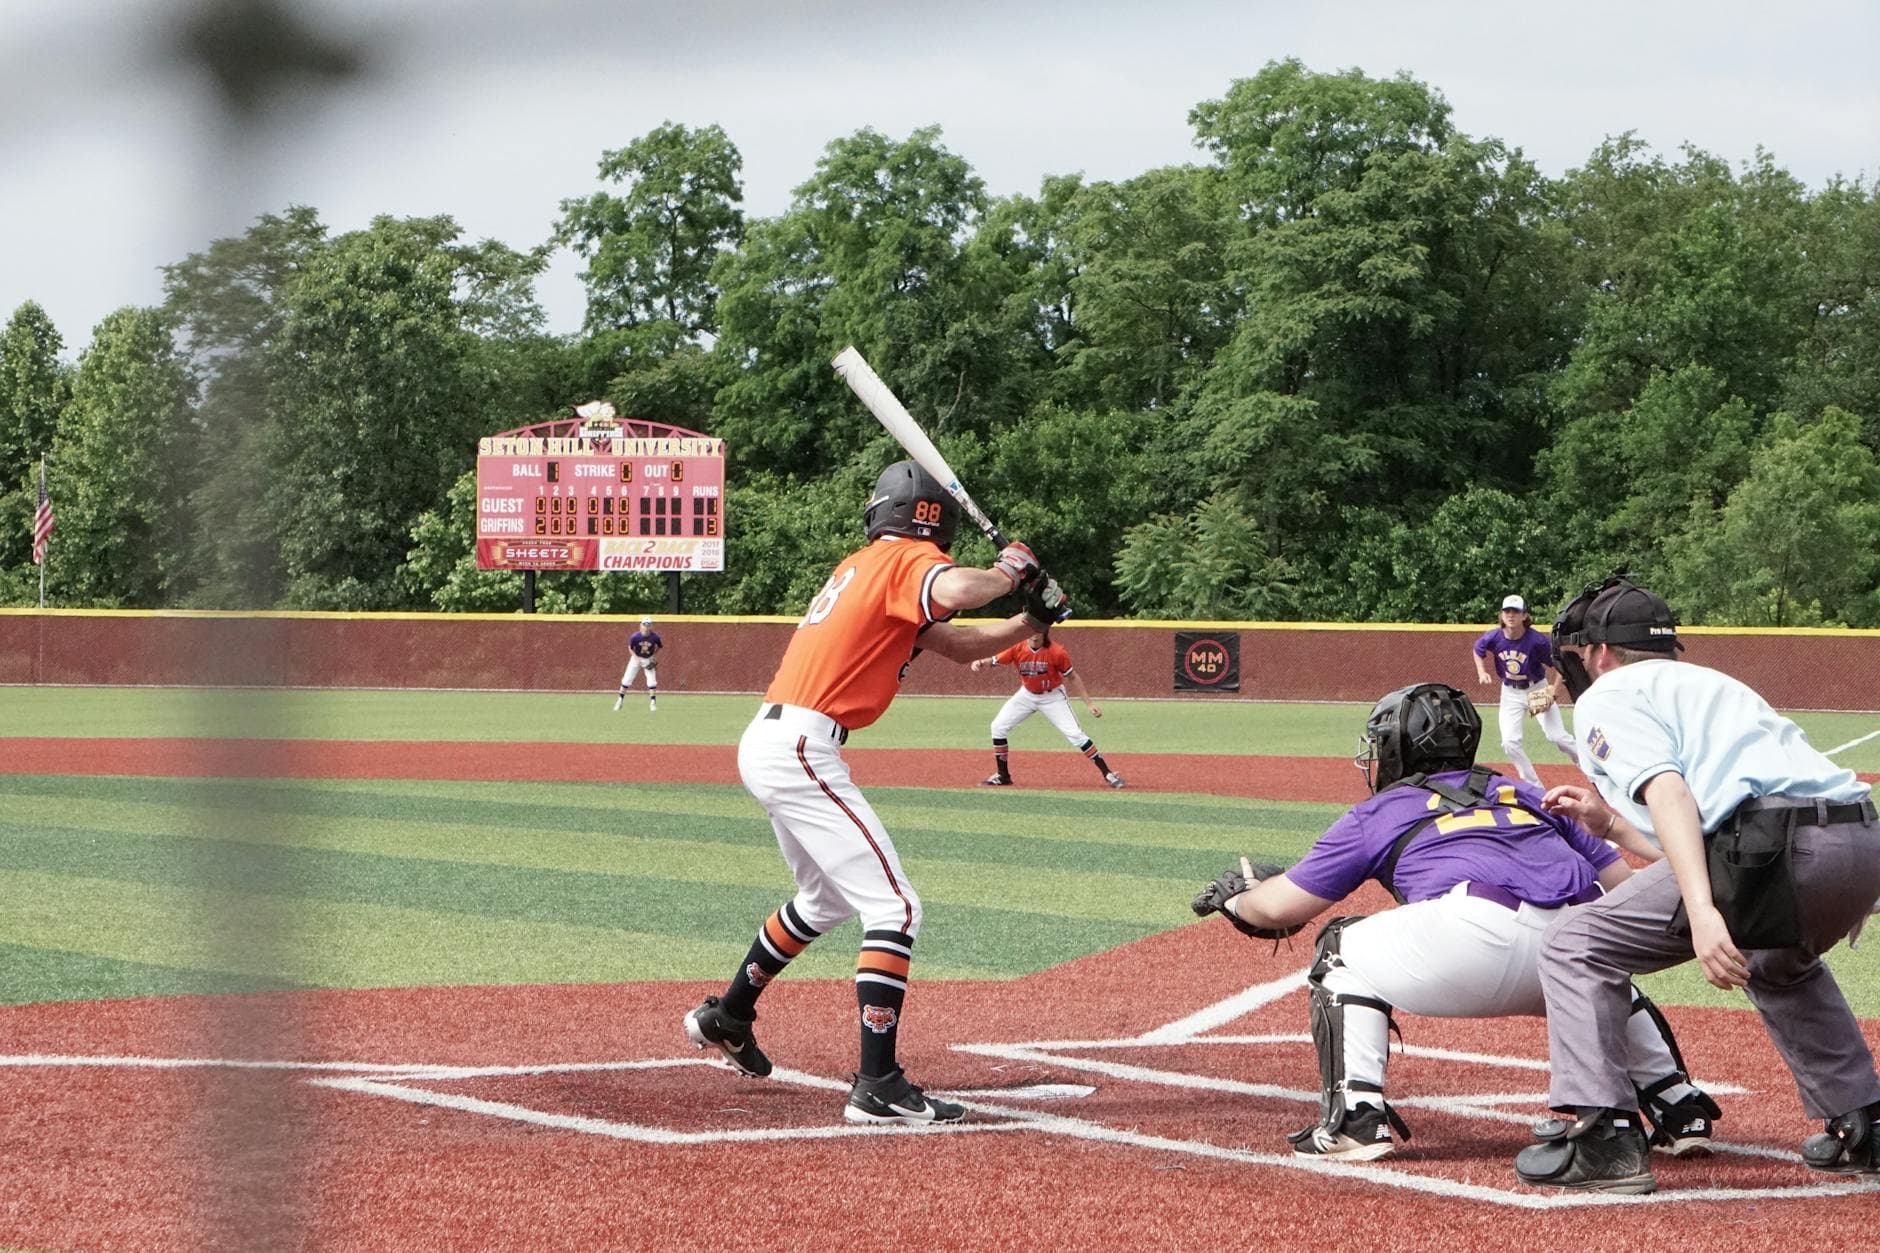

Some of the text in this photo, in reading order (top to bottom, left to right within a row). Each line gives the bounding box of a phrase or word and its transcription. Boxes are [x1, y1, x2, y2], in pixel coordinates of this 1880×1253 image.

[480, 437, 723, 457] SETON HILL UNIVERSITY
[512, 464, 542, 477] BALL
[574, 464, 616, 477] STRIKE
[621, 462, 632, 482] 0
[644, 464, 669, 478] OUT
[671, 461, 683, 481] 0
[552, 486, 560, 496] 2
[567, 486, 575, 496] 3
[590, 486, 597, 496] 4
[605, 486, 613, 496] 5
[621, 486, 628, 496] 6
[643, 486, 650, 496] 7
[672, 486, 680, 496] 9
[692, 486, 719, 496] RUNS
[481, 498, 524, 513] GUEST
[536, 497, 545, 513] 0
[552, 497, 561, 513] 0
[567, 497, 576, 513] 0
[588, 497, 598, 513] 0
[620, 497, 629, 514] 0
[915, 500, 941, 522] 88
[480, 518, 524, 533] GRIFFINS
[536, 517, 545, 533] 2
[552, 517, 561, 533] 0
[567, 517, 576, 533] 0
[603, 517, 613, 534] 0
[620, 517, 629, 534] 0
[708, 518, 717, 534] 3
[505, 548, 569, 559] SHEETZ
[603, 556, 693, 569] CHAMPIONS
[1191, 652, 1223, 663] MM
[1197, 664, 1216, 672] 40
